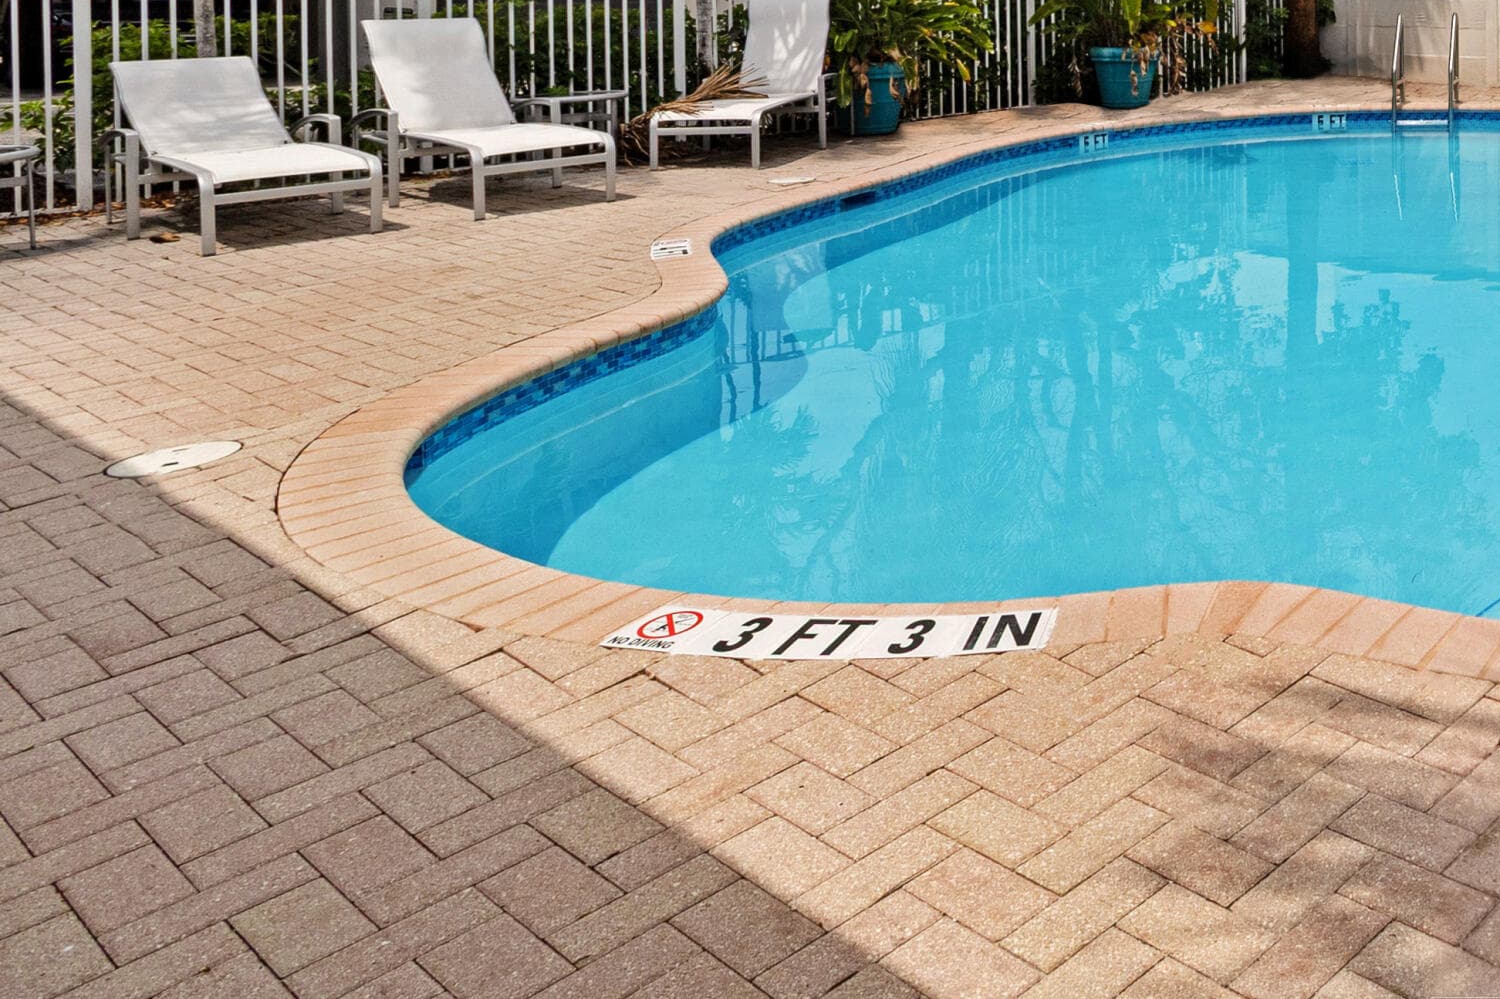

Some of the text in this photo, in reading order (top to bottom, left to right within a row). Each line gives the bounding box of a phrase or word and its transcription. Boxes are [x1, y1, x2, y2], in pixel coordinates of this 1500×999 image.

[1330, 114, 1344, 128] FT
[712, 612, 1042, 656] 3 FT 3 IN
[607, 635, 675, 649] NO DIVING
